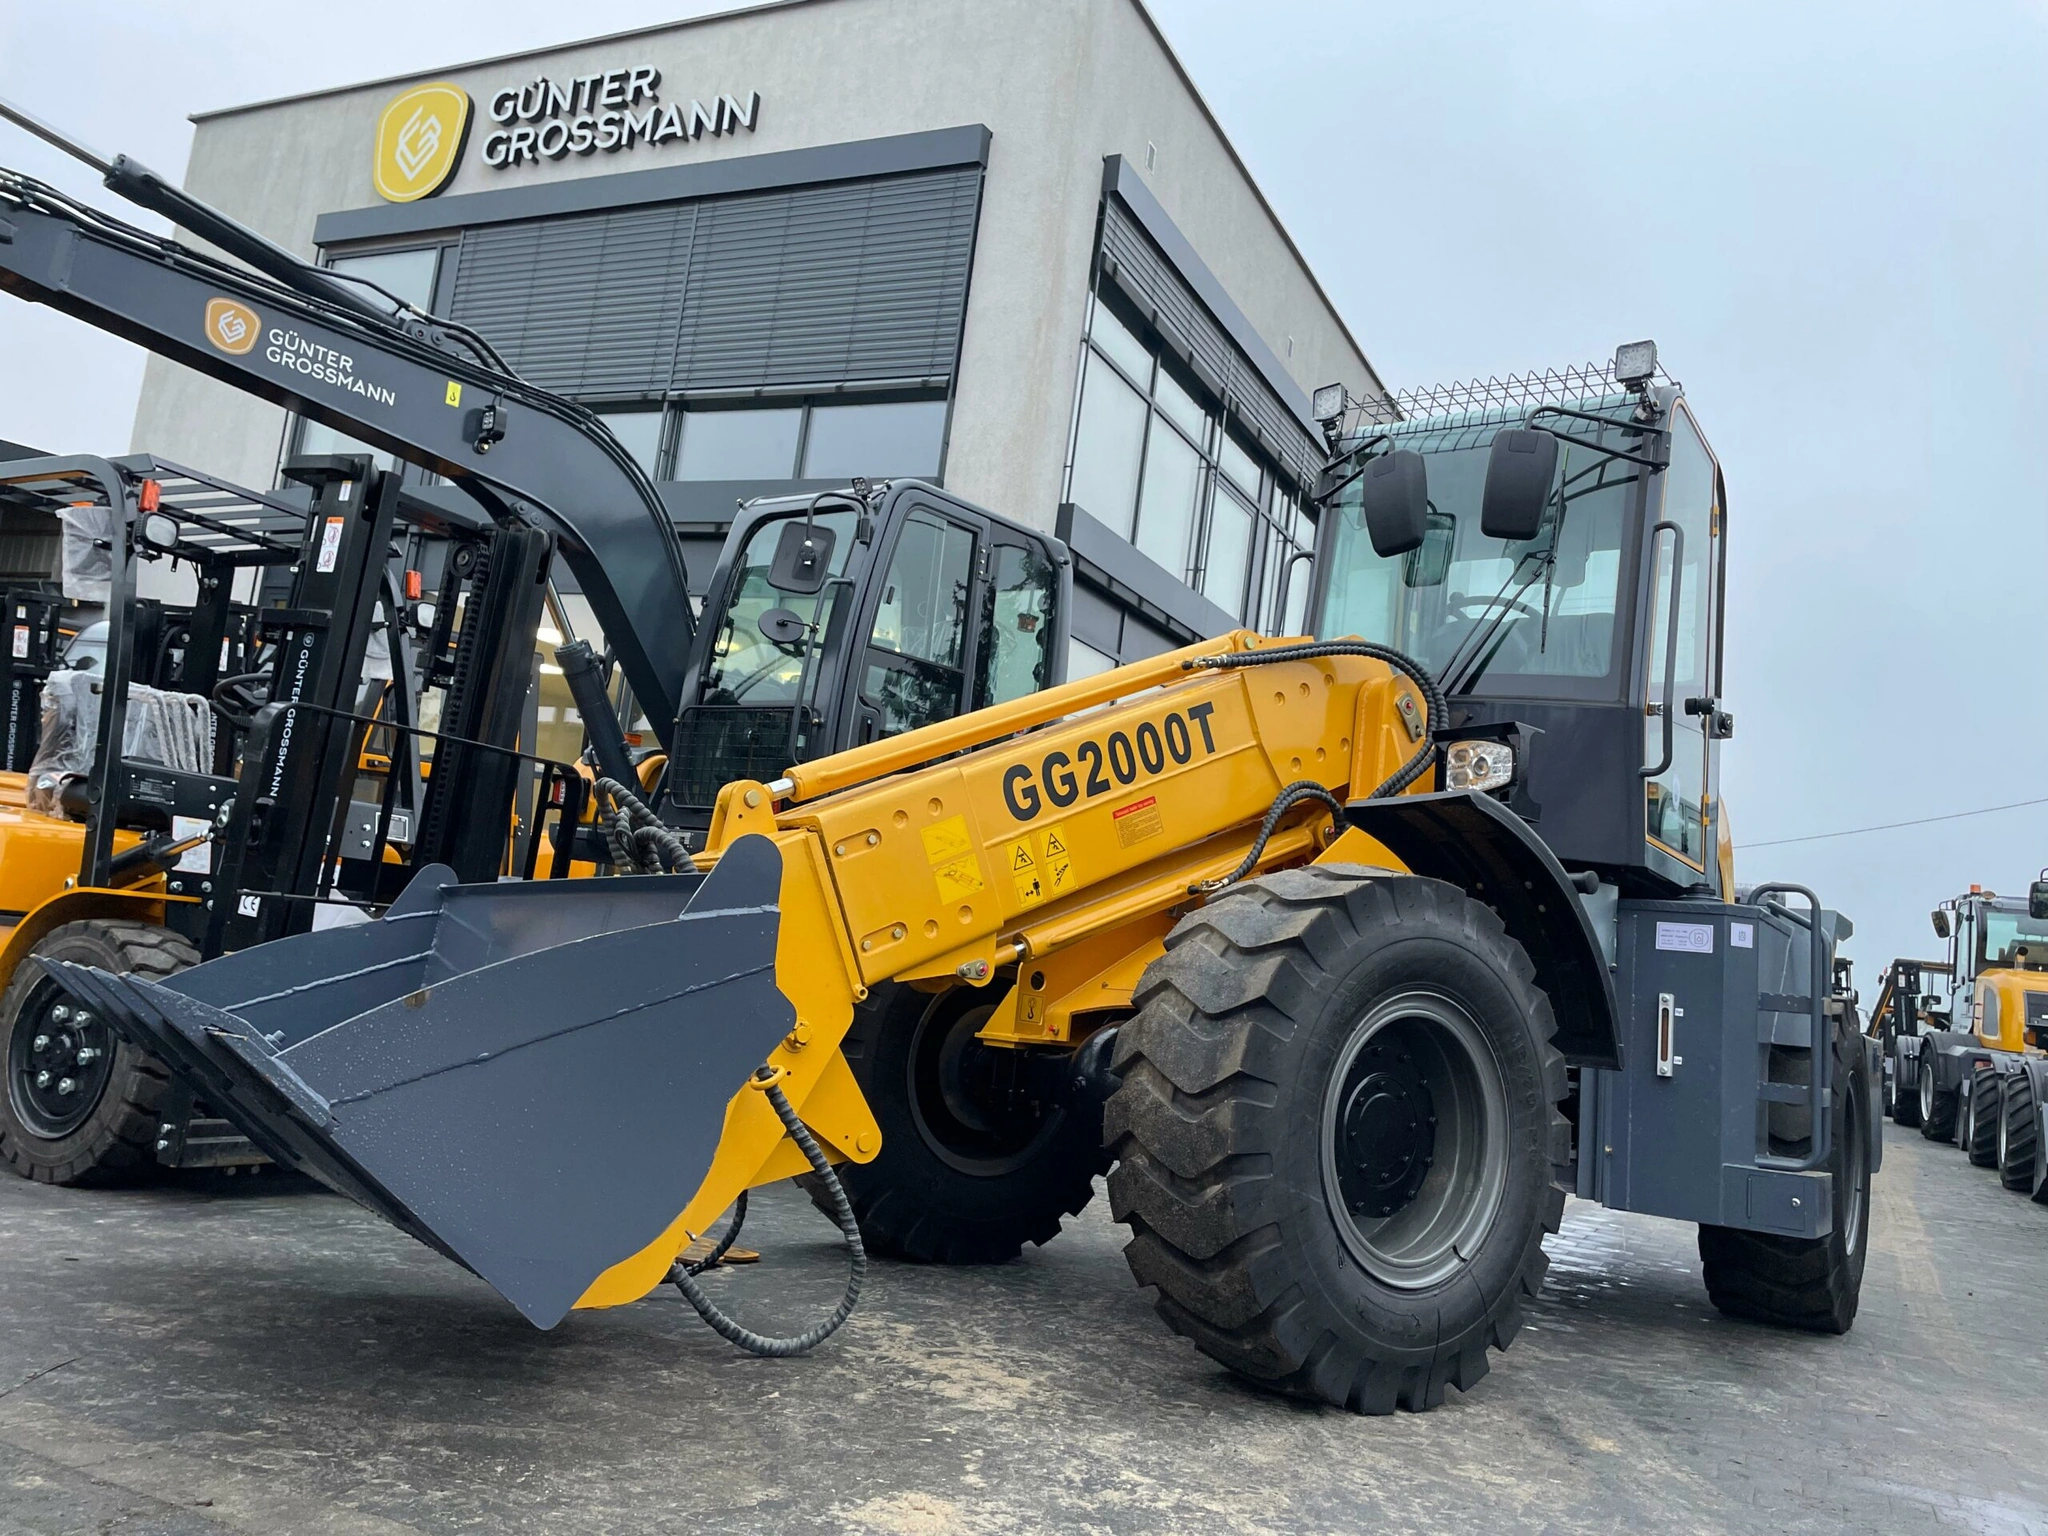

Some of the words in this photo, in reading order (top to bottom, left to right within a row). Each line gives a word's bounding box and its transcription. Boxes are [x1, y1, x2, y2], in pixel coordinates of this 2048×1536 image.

[488, 64, 659, 123] GÜNTER
[481, 90, 757, 167] GROSSMANN
[266, 346, 396, 407] GROSSMANN
[268, 328, 354, 373] GÜNTER
[10, 689, 20, 721] GÜNTER
[291, 649, 309, 704] GÜNTER
[269, 708, 296, 797] GROSSMANN
[1002, 701, 1216, 821] GG2000T
